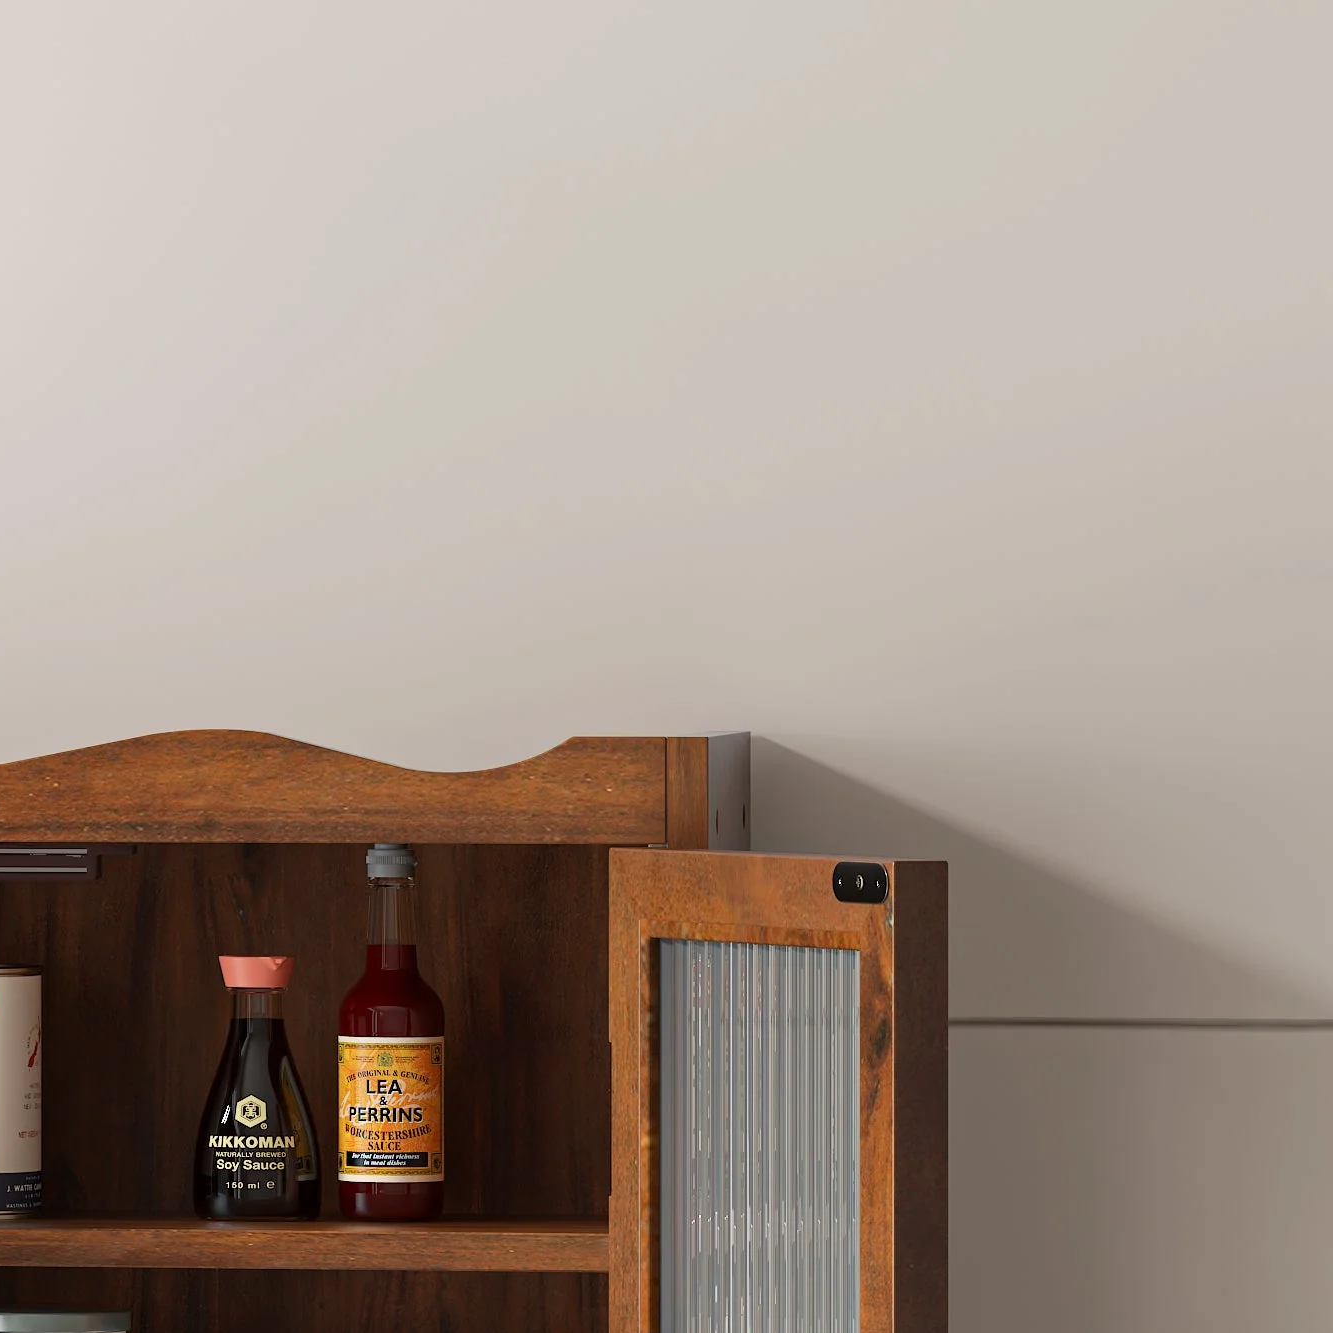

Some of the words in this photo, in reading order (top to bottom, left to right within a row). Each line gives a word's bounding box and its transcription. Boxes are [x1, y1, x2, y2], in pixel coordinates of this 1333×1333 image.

[357, 1069, 390, 1078] ORIGINAL
[400, 1070, 429, 1084] GENUINE
[366, 1079, 403, 1095] LEA
[379, 1096, 388, 1106] &
[349, 1107, 423, 1122] PERRINS
[345, 1123, 432, 1140] WORCESTERSHIRE
[208, 1135, 295, 1149] KIKKOMAN
[367, 1141, 401, 1151] SAUCE
[216, 1158, 239, 1172] Soy
[243, 1160, 285, 1170] Sauce
[247, 1181, 260, 1189] ml
